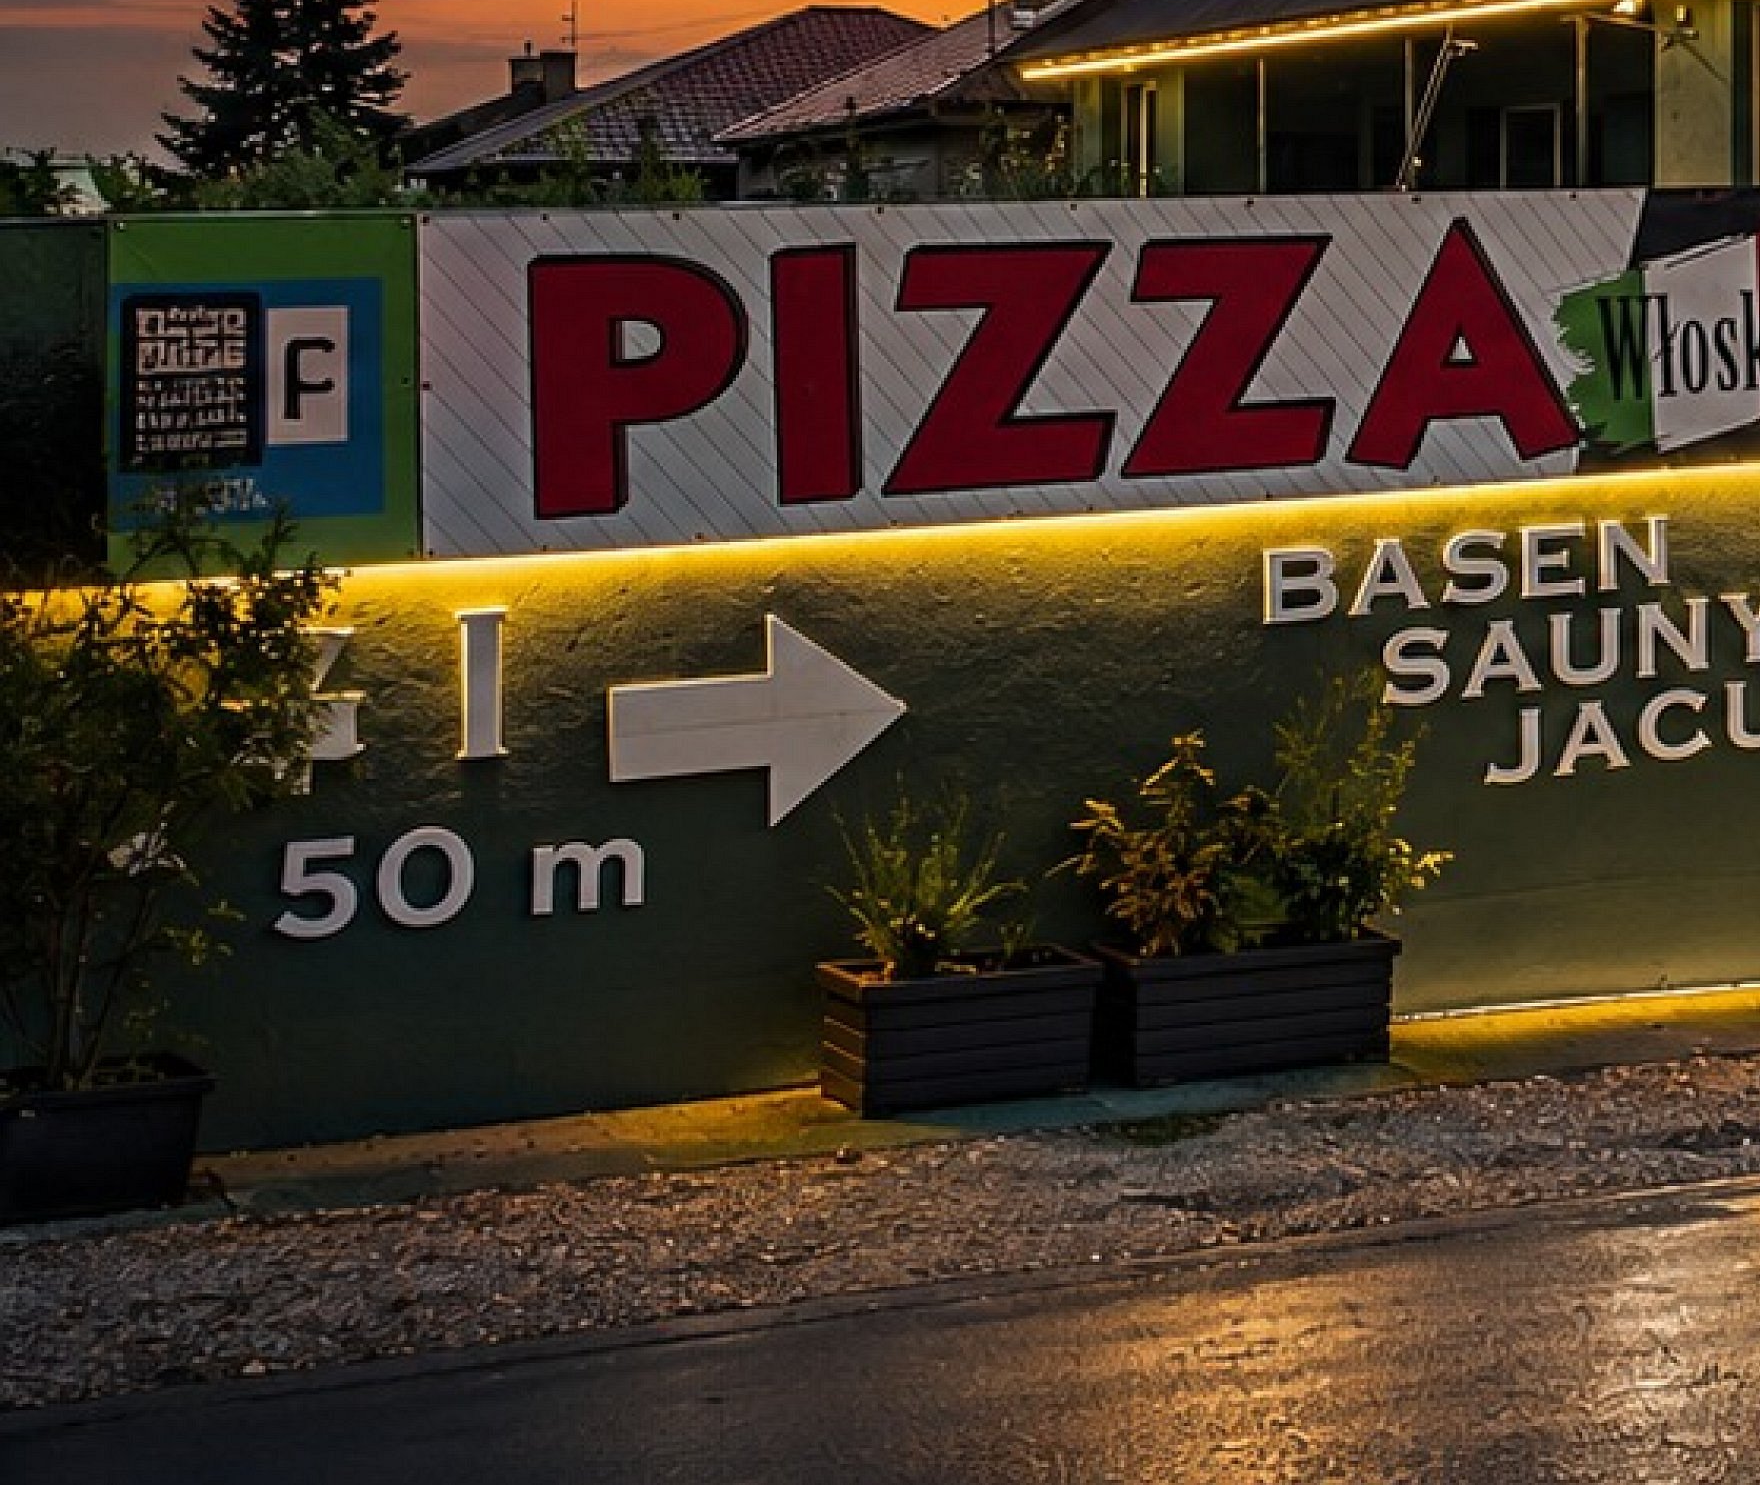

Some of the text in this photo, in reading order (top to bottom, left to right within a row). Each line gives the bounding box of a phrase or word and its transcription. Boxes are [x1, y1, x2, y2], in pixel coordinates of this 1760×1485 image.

[528, 216, 1582, 519] PIZZA
[1262, 516, 1670, 624] BASEN
[274, 826, 646, 939] 50 m
